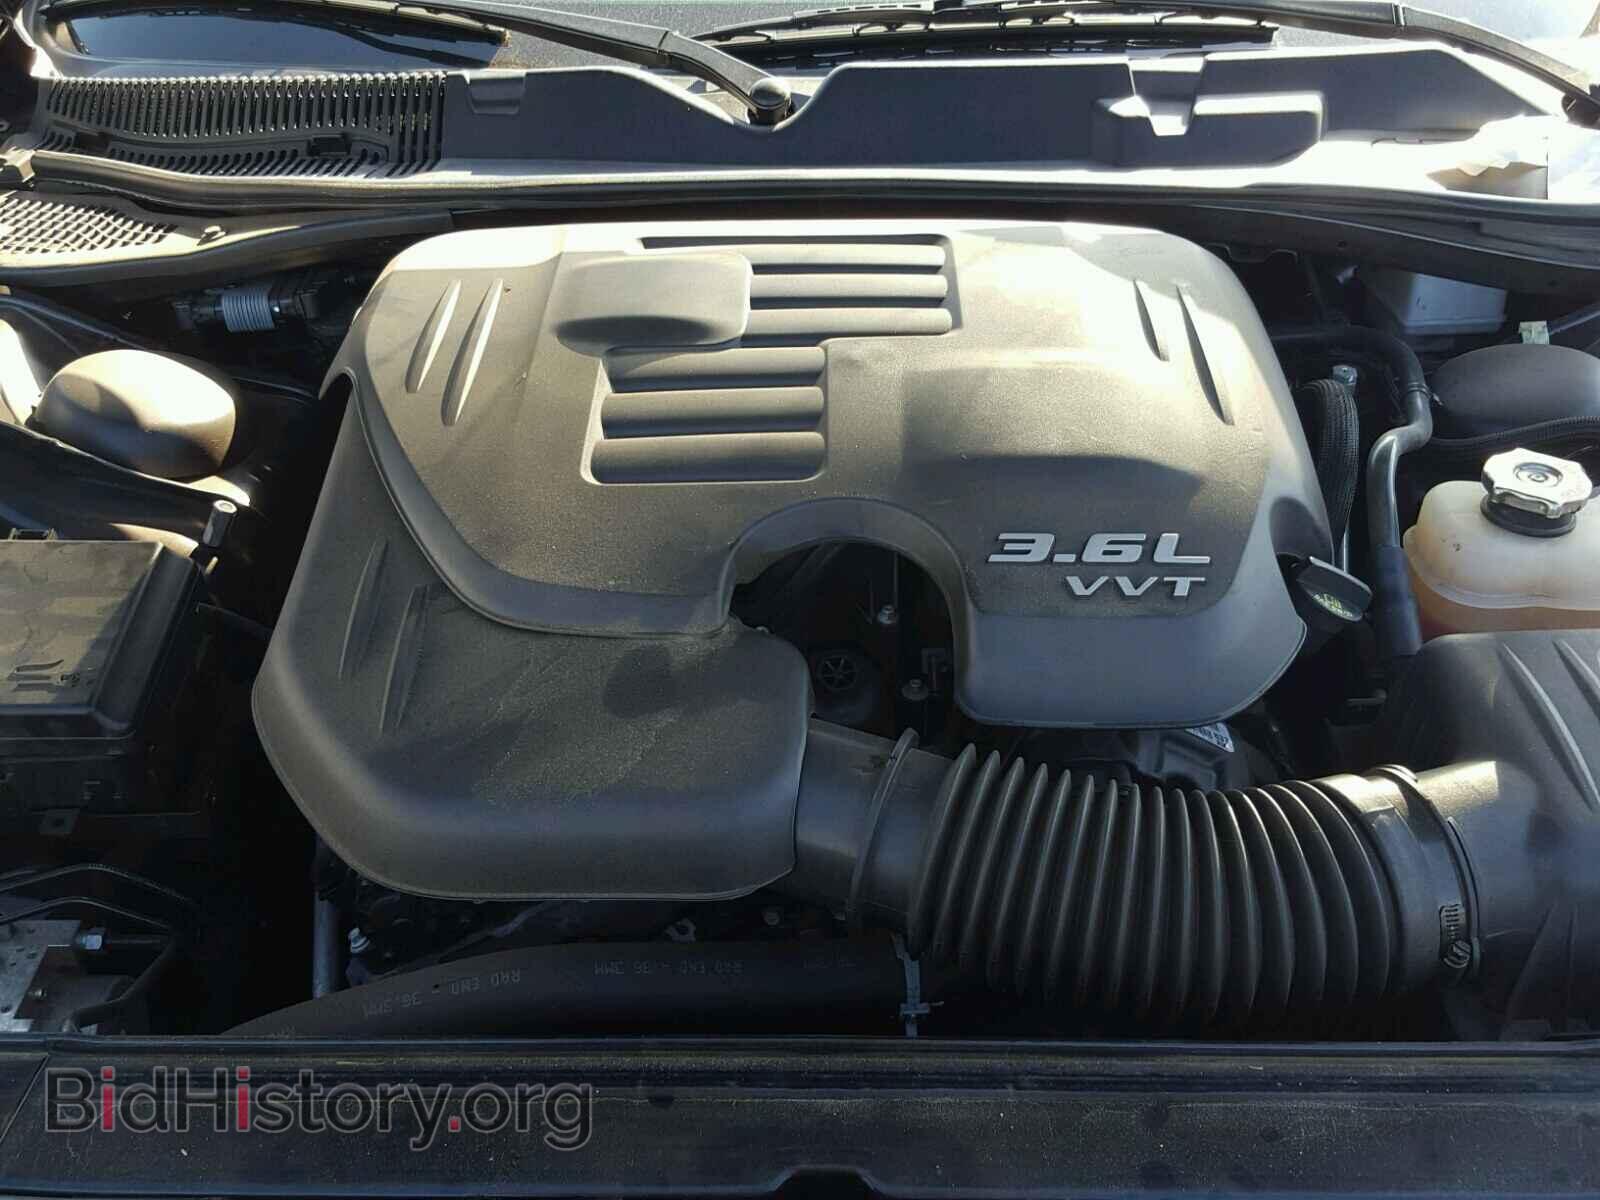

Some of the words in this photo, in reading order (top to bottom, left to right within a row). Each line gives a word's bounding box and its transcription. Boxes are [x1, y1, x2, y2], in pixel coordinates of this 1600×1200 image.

[987, 532, 1211, 564] 3.6L
[1065, 575, 1207, 597] VVT
[450, 976, 481, 996] END
[490, 968, 521, 987] RAD
